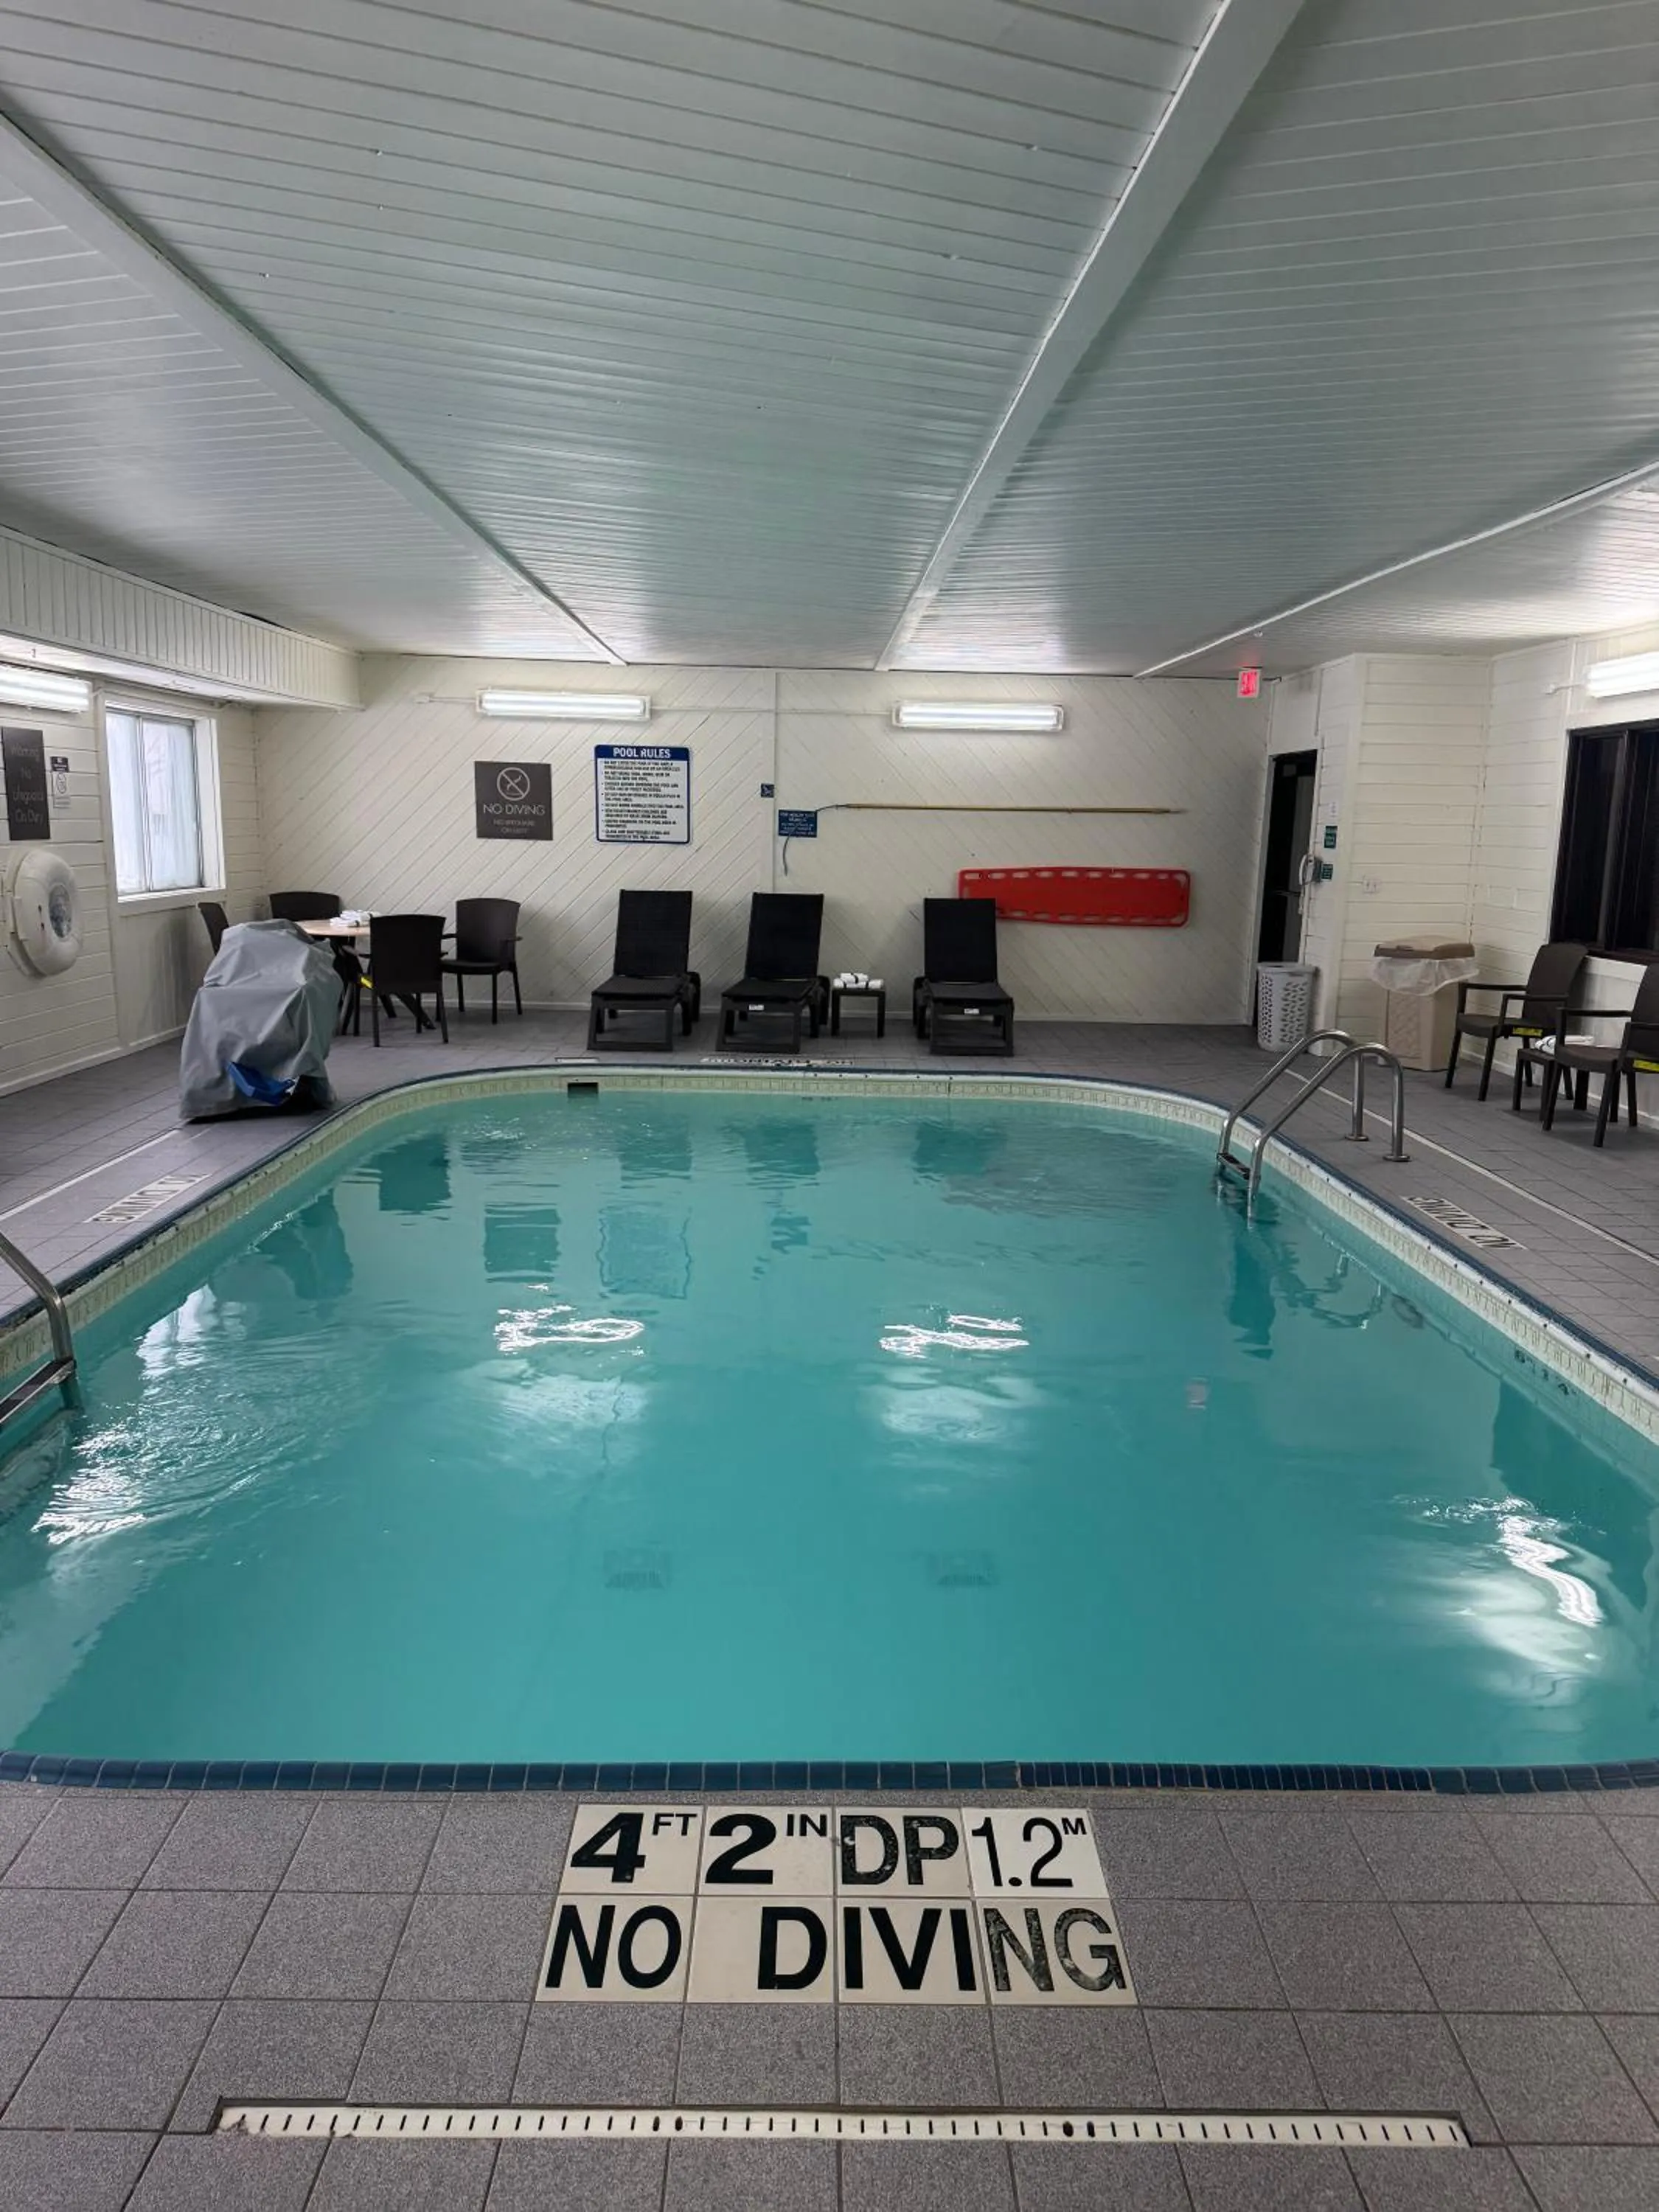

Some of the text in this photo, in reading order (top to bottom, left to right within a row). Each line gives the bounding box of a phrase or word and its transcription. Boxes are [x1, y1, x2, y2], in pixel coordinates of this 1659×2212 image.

[613, 748, 671, 758] POOL RULES
[483, 803, 546, 816] NO DIVING
[840, 1815, 959, 1885] DP
[546, 1905, 1127, 1992] NO DIVING
